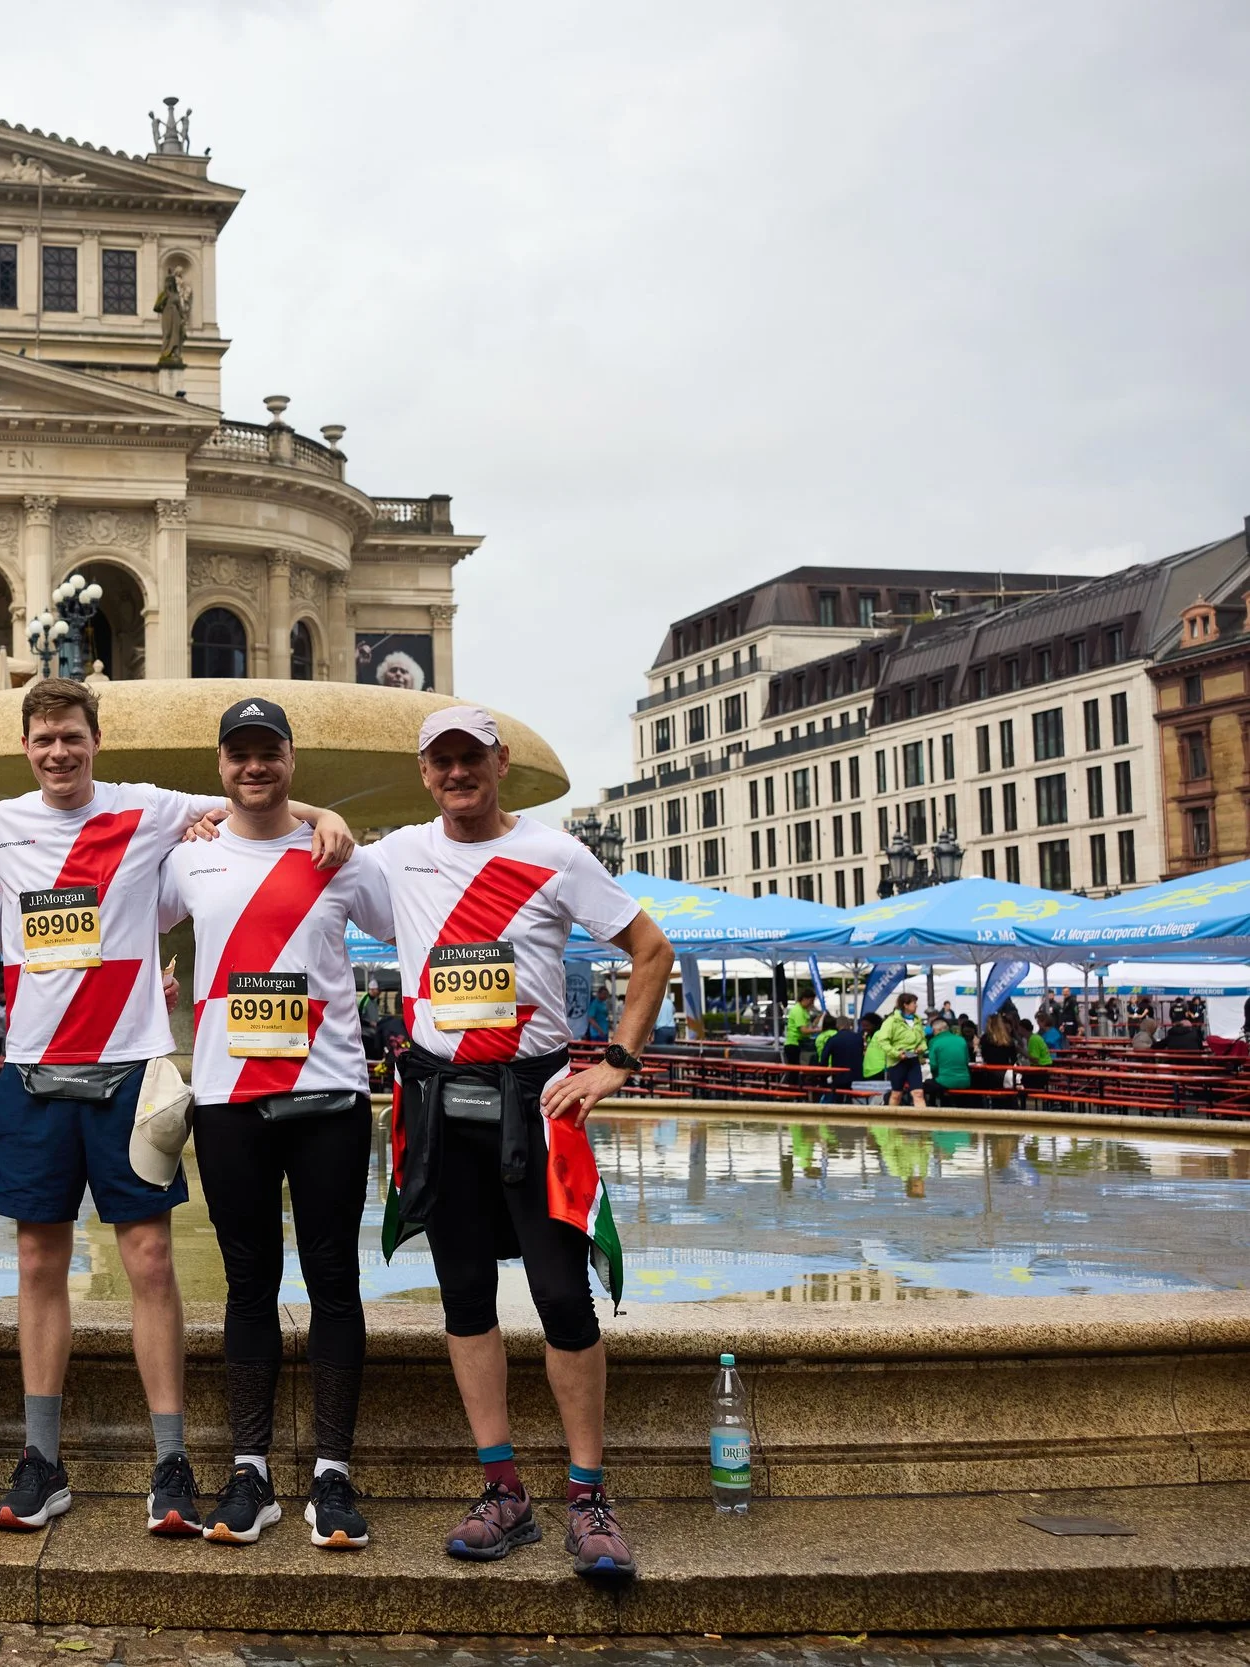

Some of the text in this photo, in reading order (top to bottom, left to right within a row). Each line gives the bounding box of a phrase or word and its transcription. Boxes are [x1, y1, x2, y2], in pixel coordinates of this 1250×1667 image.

[240, 709, 264, 718] adidas
[0, 840, 31, 849] dormakaba
[189, 867, 220, 877] dormakaba
[404, 866, 433, 874] dormakaba
[29, 892, 85, 907] J.P.Morgan
[26, 911, 95, 938] 69908
[663, 926, 723, 940] Corporate
[1051, 929, 1066, 941] J.P.
[1067, 927, 1101, 942] Morgan
[1101, 925, 1147, 941] Corporate
[439, 947, 500, 962] J.P.Morgan
[236, 977, 296, 991] J.P.Morgan
[433, 968, 510, 994] 69909
[1189, 987, 1224, 995] GARDEROBE
[230, 998, 304, 1021] 69910
[293, 1093, 324, 1102] dormakaba
[452, 1097, 485, 1105] dormakaba
